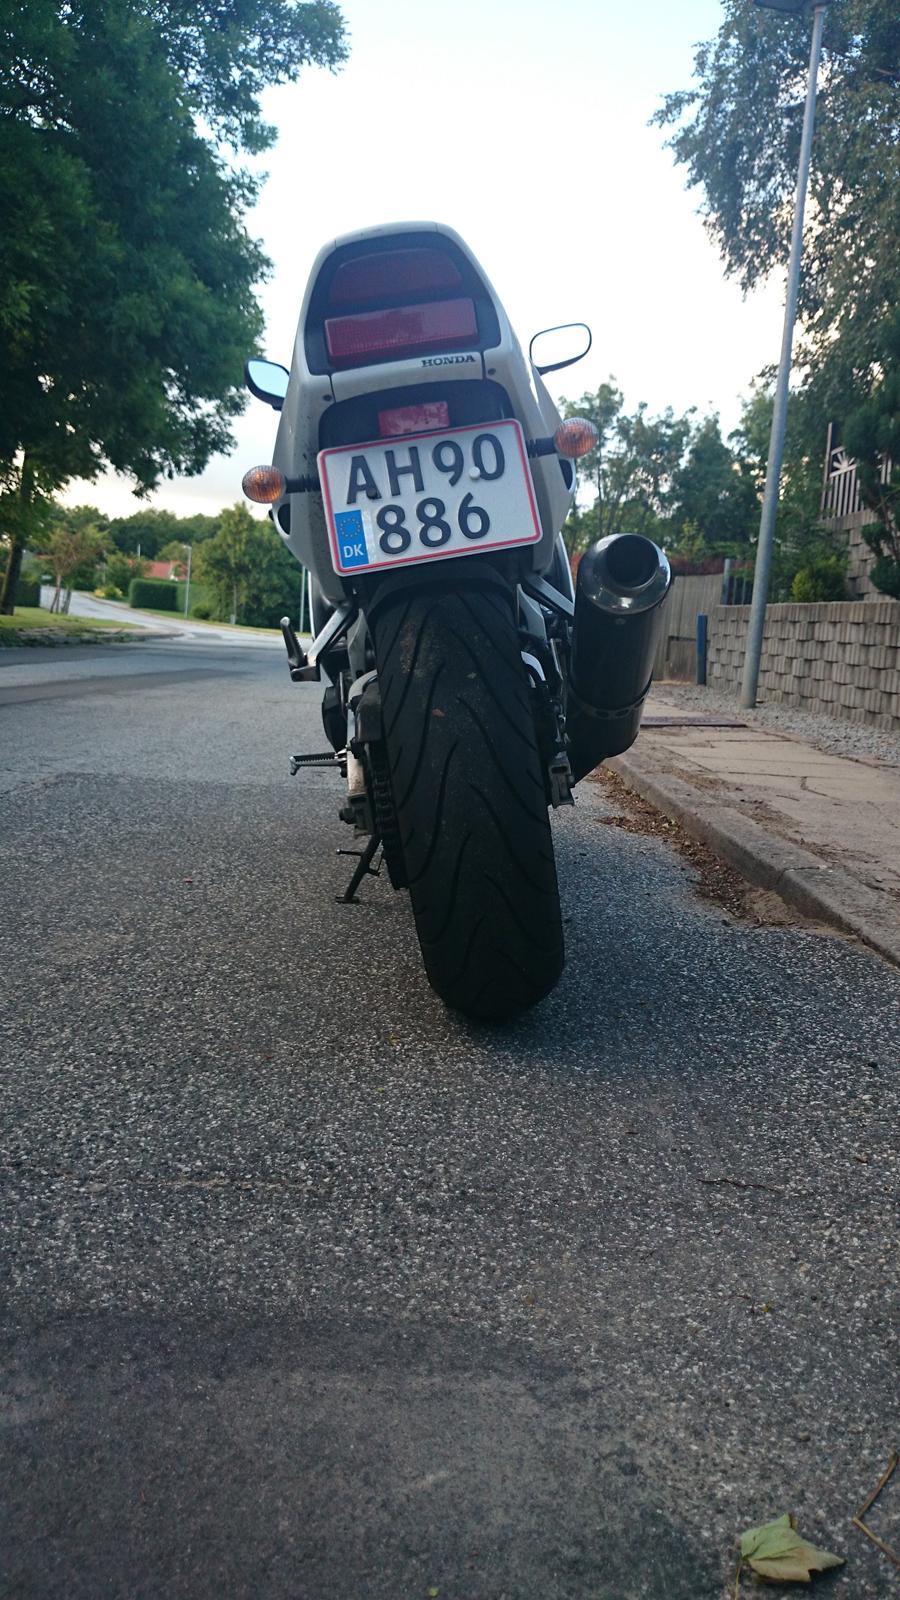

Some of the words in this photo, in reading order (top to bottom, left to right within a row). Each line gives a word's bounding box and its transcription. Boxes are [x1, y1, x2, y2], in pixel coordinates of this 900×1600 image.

[421, 354, 476, 367] HONDA
[376, 492, 490, 554] 886
[343, 543, 364, 558] DK
